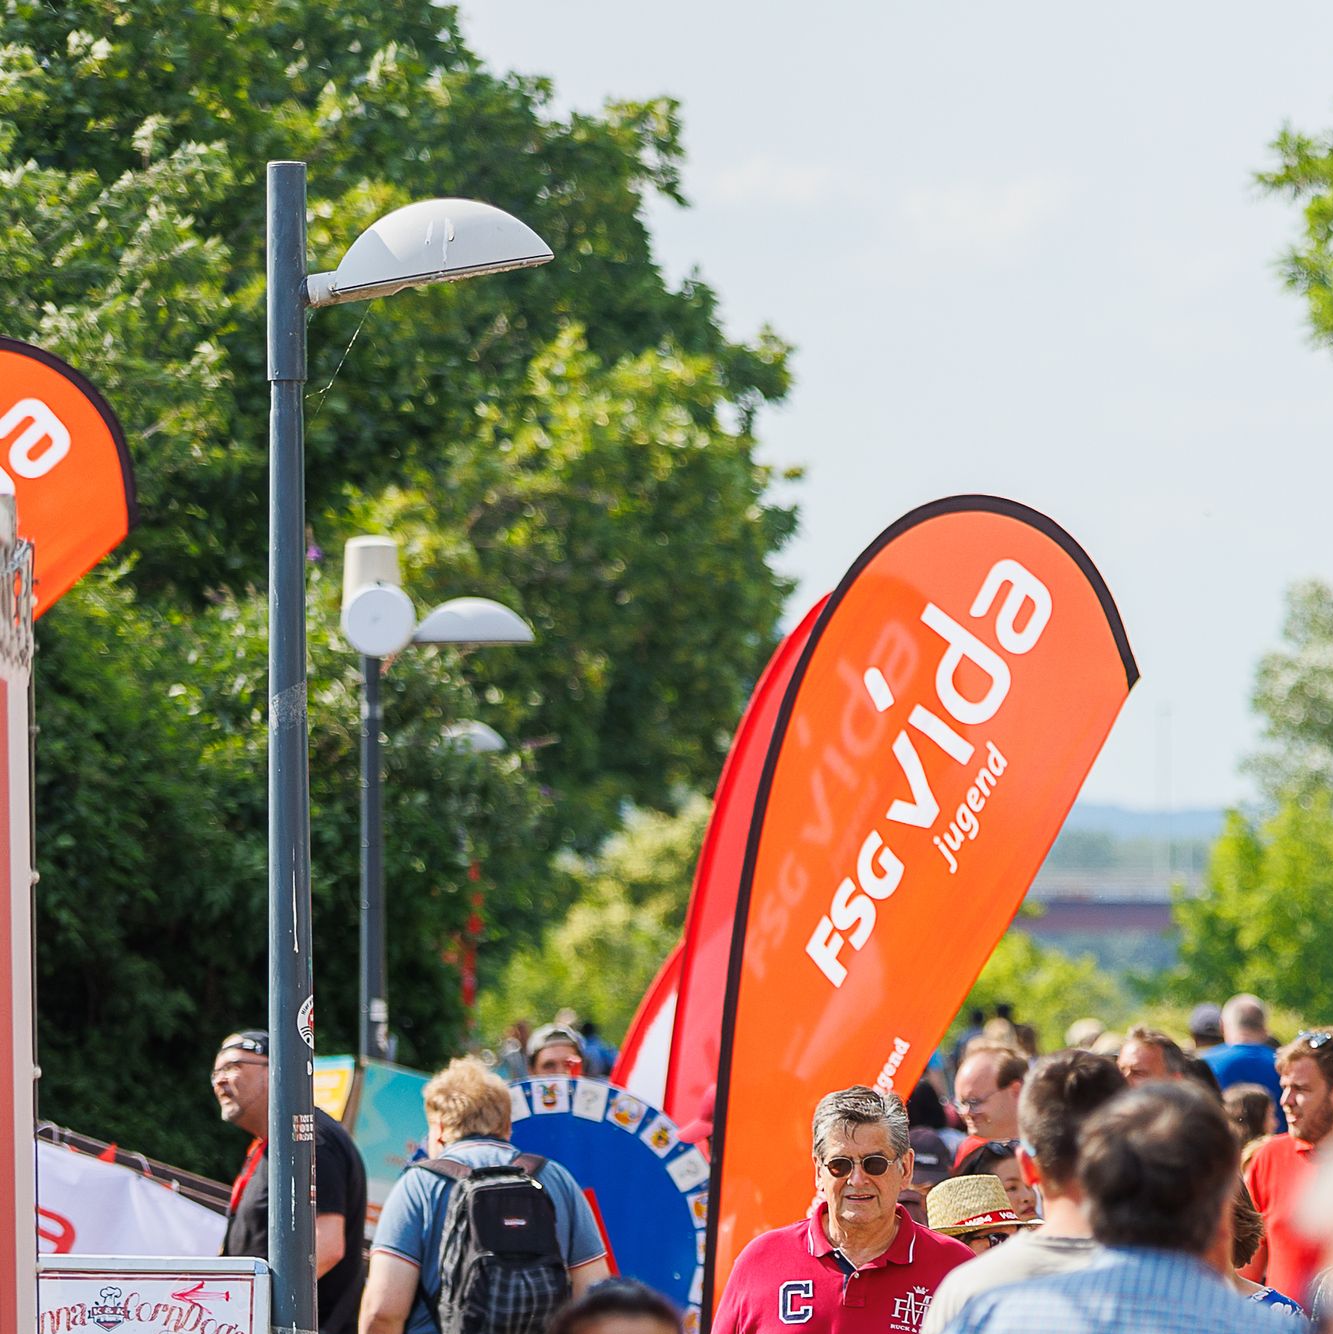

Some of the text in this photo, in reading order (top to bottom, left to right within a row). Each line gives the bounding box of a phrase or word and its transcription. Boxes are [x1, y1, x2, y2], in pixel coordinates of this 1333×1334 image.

[805, 558, 1053, 988] FSG vida
[932, 740, 1008, 874] jugend
[778, 1279, 814, 1325] C
